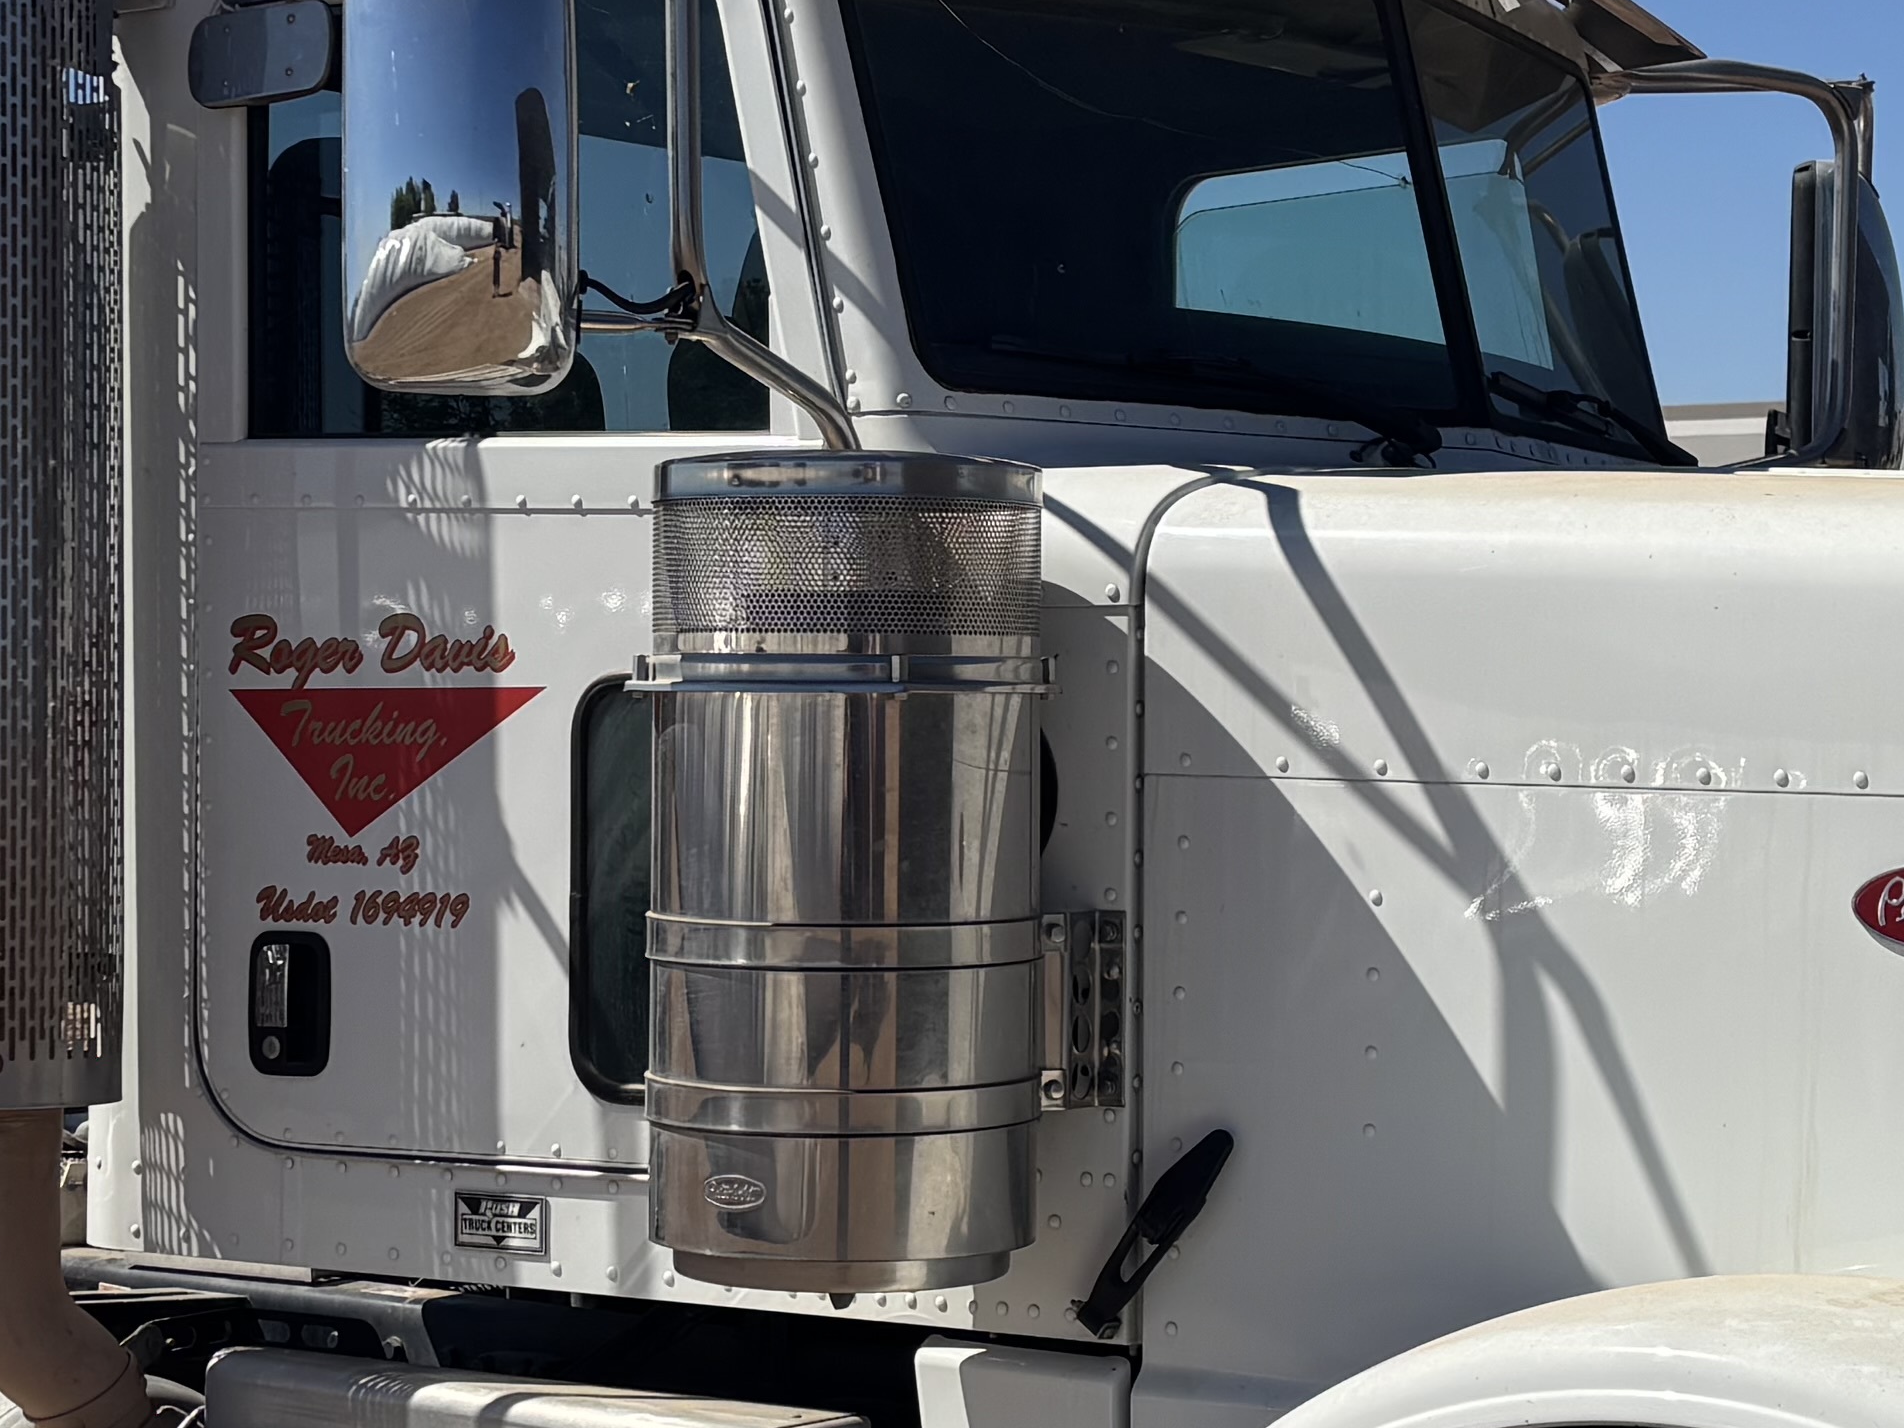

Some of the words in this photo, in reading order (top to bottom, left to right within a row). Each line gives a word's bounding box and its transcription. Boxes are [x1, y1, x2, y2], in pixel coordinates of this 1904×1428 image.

[229, 614, 363, 690] Roger
[378, 613, 515, 674] Davis
[330, 754, 395, 802] Inc.
[377, 835, 420, 875] AZ
[256, 885, 339, 924] Usdot
[350, 889, 470, 929] 1694919
[463, 1217, 492, 1232] TRUCK
[495, 1220, 536, 1235] CENTERS
